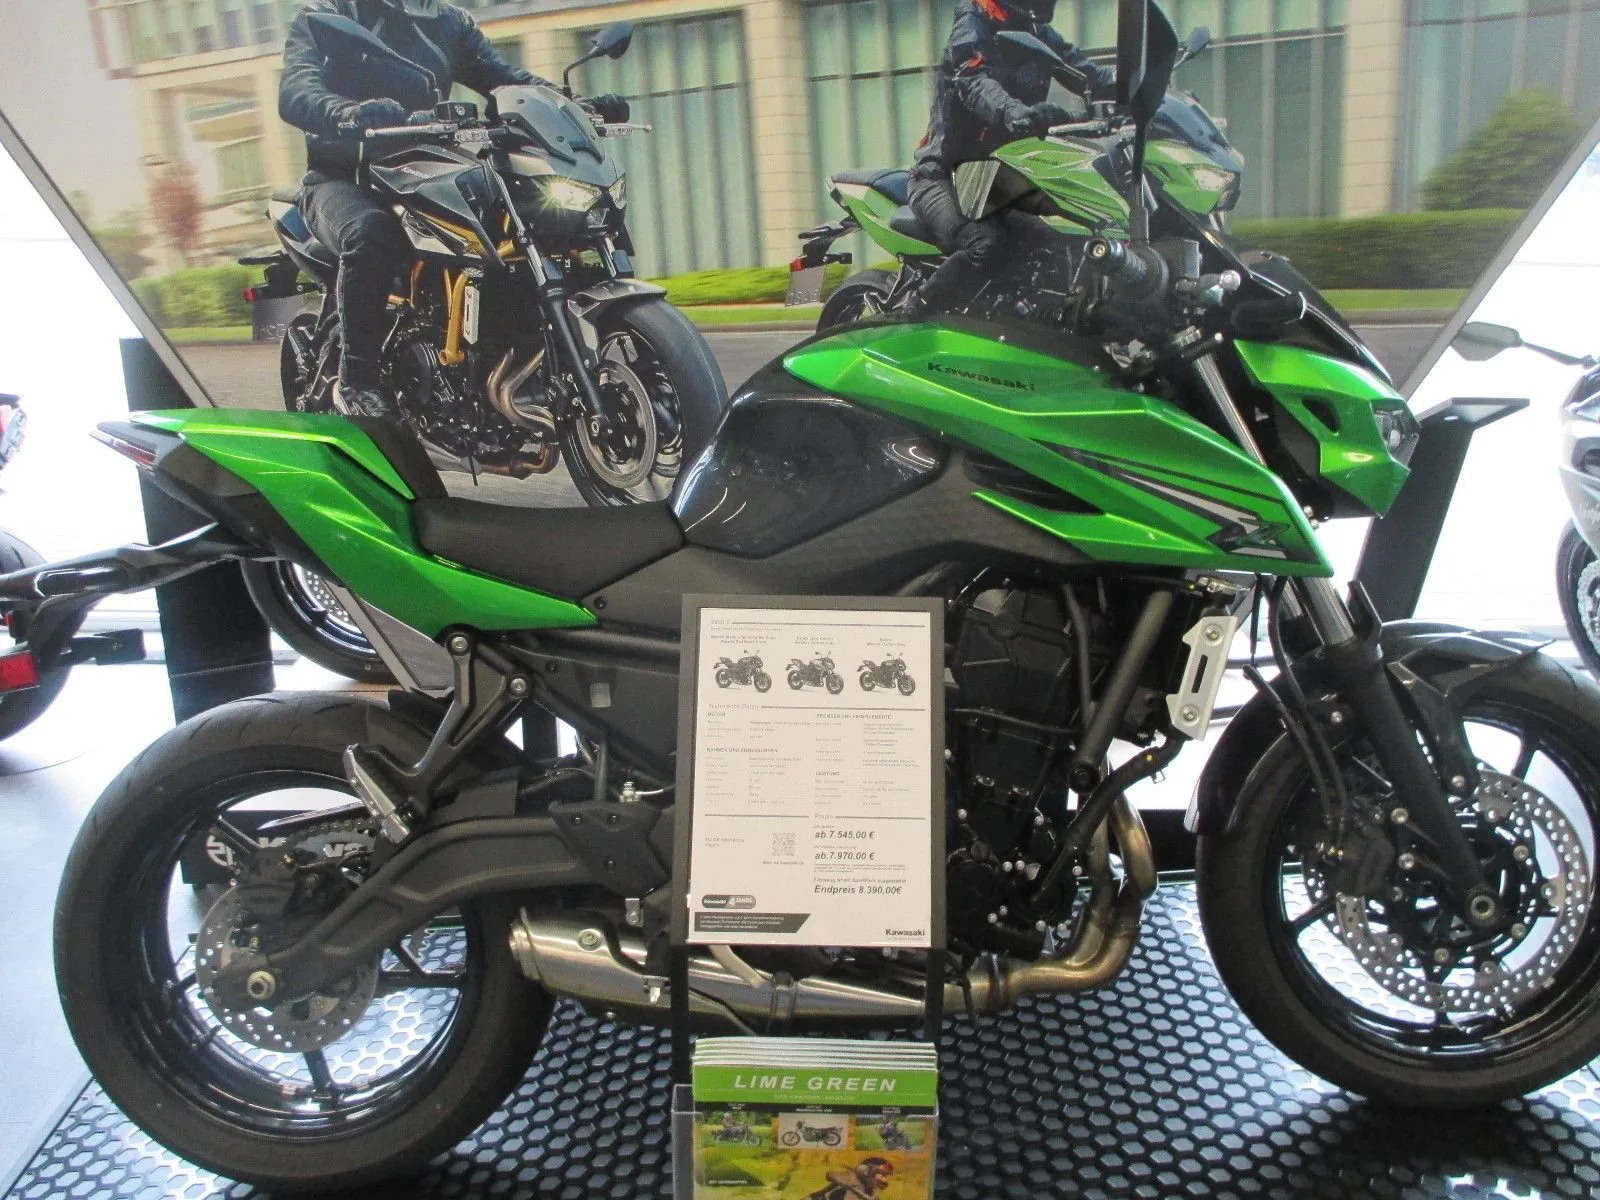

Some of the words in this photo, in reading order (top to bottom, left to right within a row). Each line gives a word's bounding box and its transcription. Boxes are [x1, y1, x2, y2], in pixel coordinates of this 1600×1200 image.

[927, 361, 1036, 392] Kawasaki
[868, 830, 875, 840] €
[868, 851, 875, 860] €
[814, 885, 856, 895] Endpreis
[728, 897, 735, 906] 4
[885, 928, 925, 937] Kawasaki
[734, 1074, 796, 1090] LIME
[807, 1076, 897, 1093] GREEN
